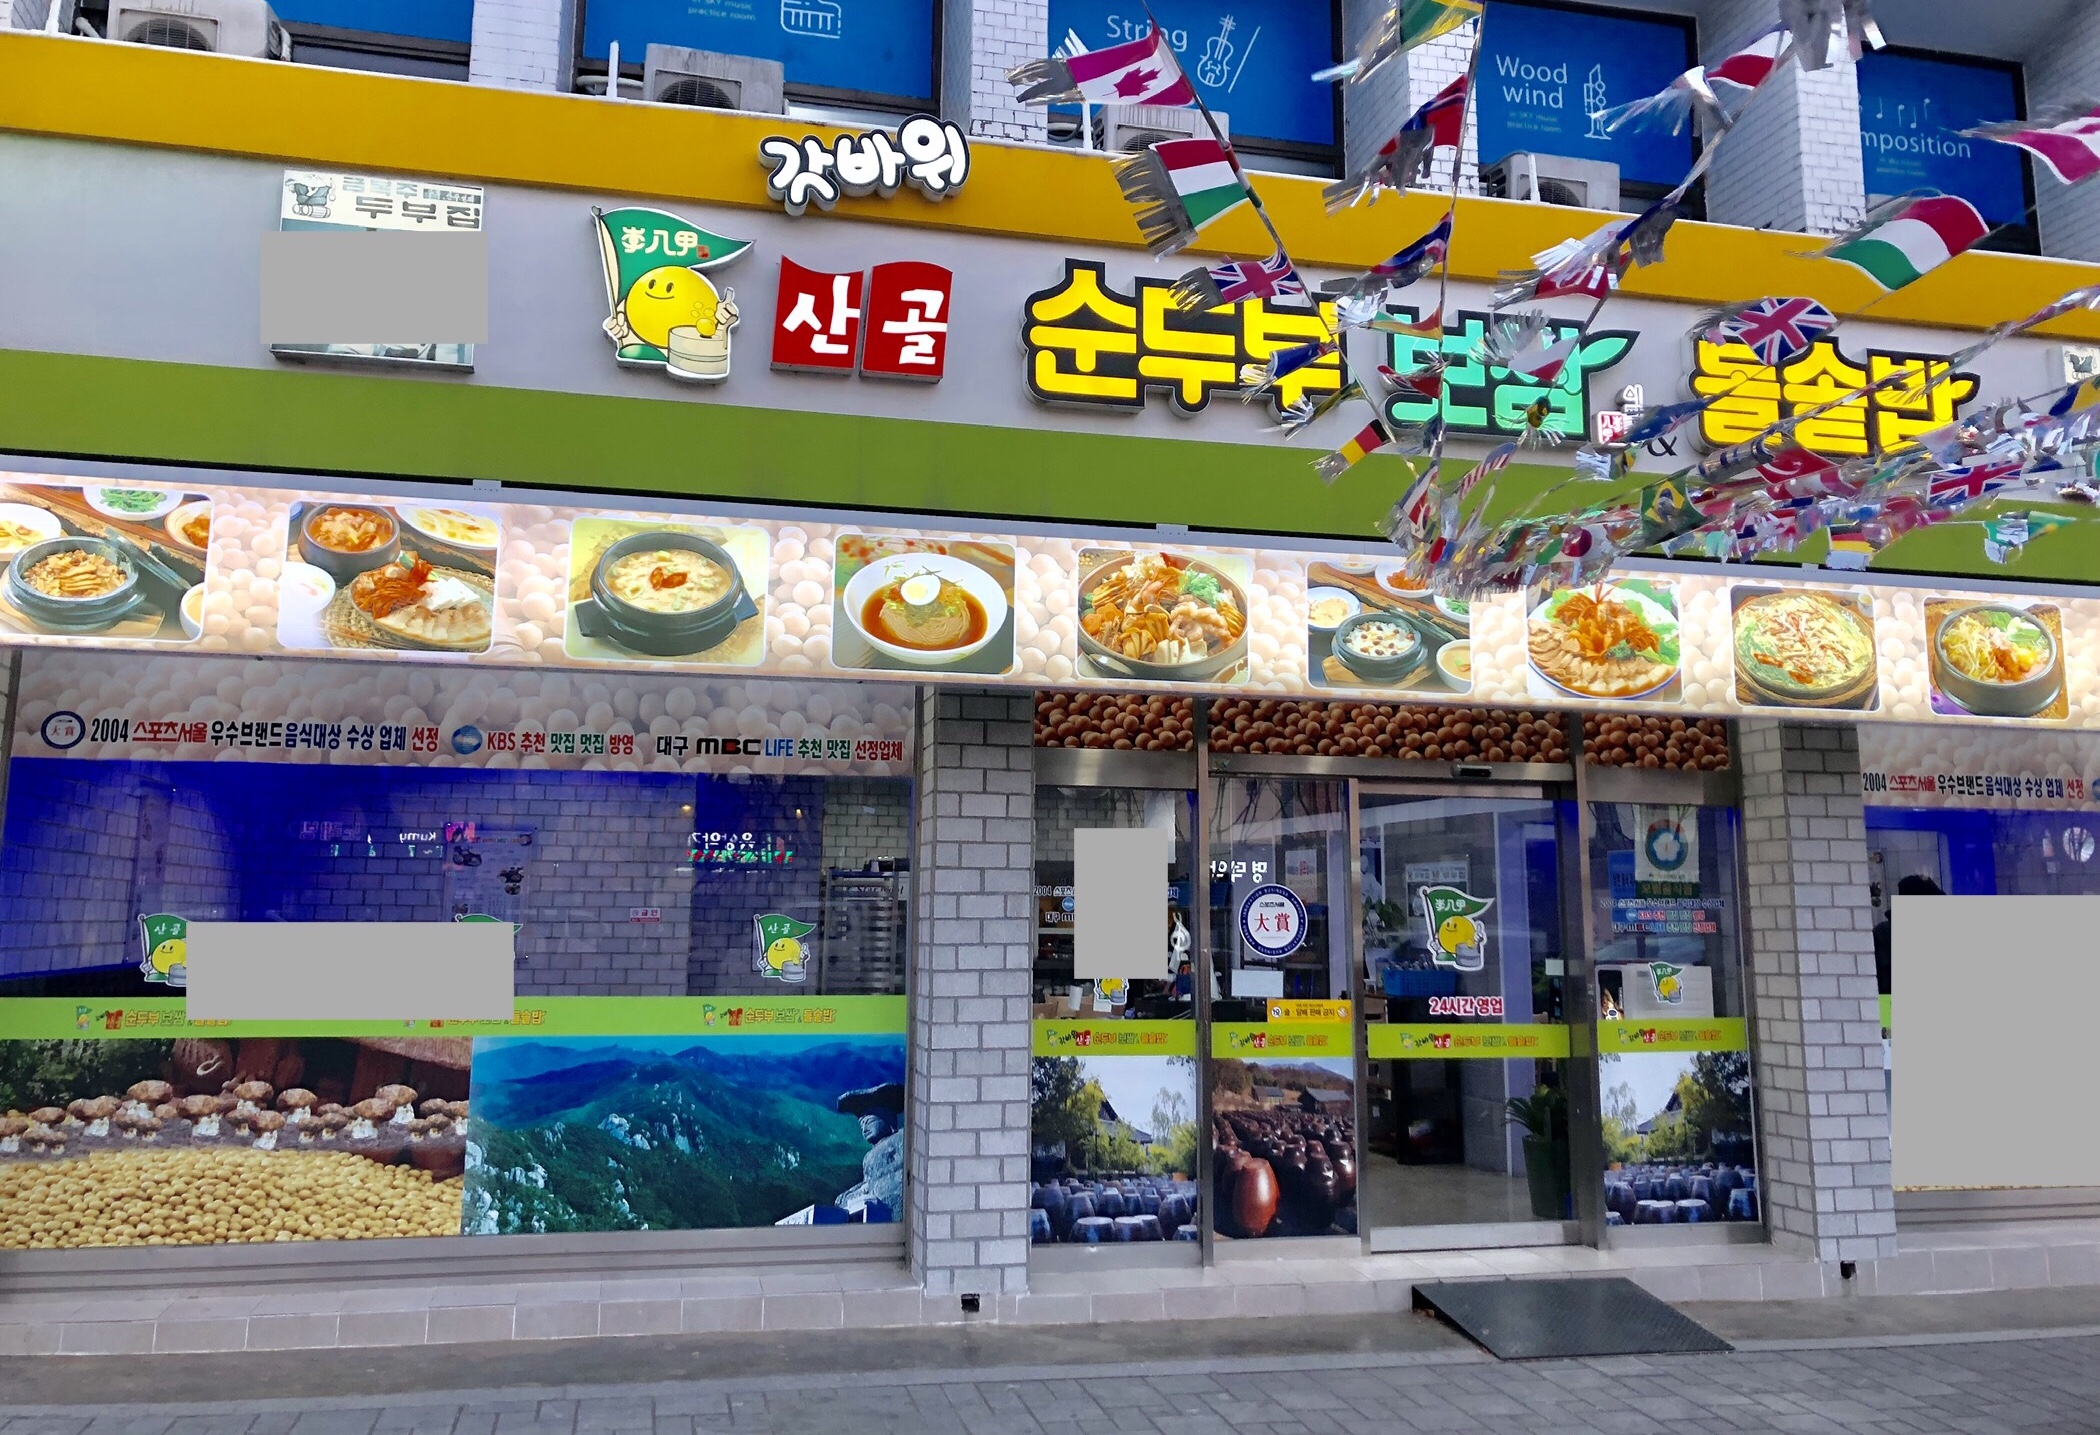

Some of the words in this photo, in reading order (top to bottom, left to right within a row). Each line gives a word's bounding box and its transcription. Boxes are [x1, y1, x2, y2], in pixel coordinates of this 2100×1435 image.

[1496, 54, 1568, 84] Wood
[1502, 83, 1564, 109] wind
[763, 116, 968, 204] 갓바위
[355, 195, 481, 230] 두부집
[782, 275, 949, 365] 산골
[1029, 268, 1342, 409] 순두부
[91, 717, 129, 743] 2004
[132, 721, 208, 744] 스포츠서울
[346, 724, 375, 751] 수상
[379, 725, 407, 751] 업체
[411, 726, 440, 752] 선정
[487, 732, 516, 751] KBS
[520, 731, 546, 753] 추천
[550, 732, 576, 754] 맛집
[580, 733, 605, 755] 멋집
[609, 734, 635, 756] 방영
[656, 736, 689, 756] 대구
[765, 739, 794, 757] LIFE
[797, 738, 822, 760] 추천
[826, 739, 851, 760] 맛집
[854, 740, 904, 761] 선정업체
[1862, 772, 1888, 793] 2004
[1889, 775, 1937, 793] 스포츠서울
[2025, 777, 2043, 798] 수상
[2046, 777, 2064, 799] 업체
[2067, 778, 2085, 800] 선정
[1253, 912, 1291, 933] 大賞
[1429, 996, 1474, 1015] 24시간
[1475, 996, 1504, 1015] 영업
